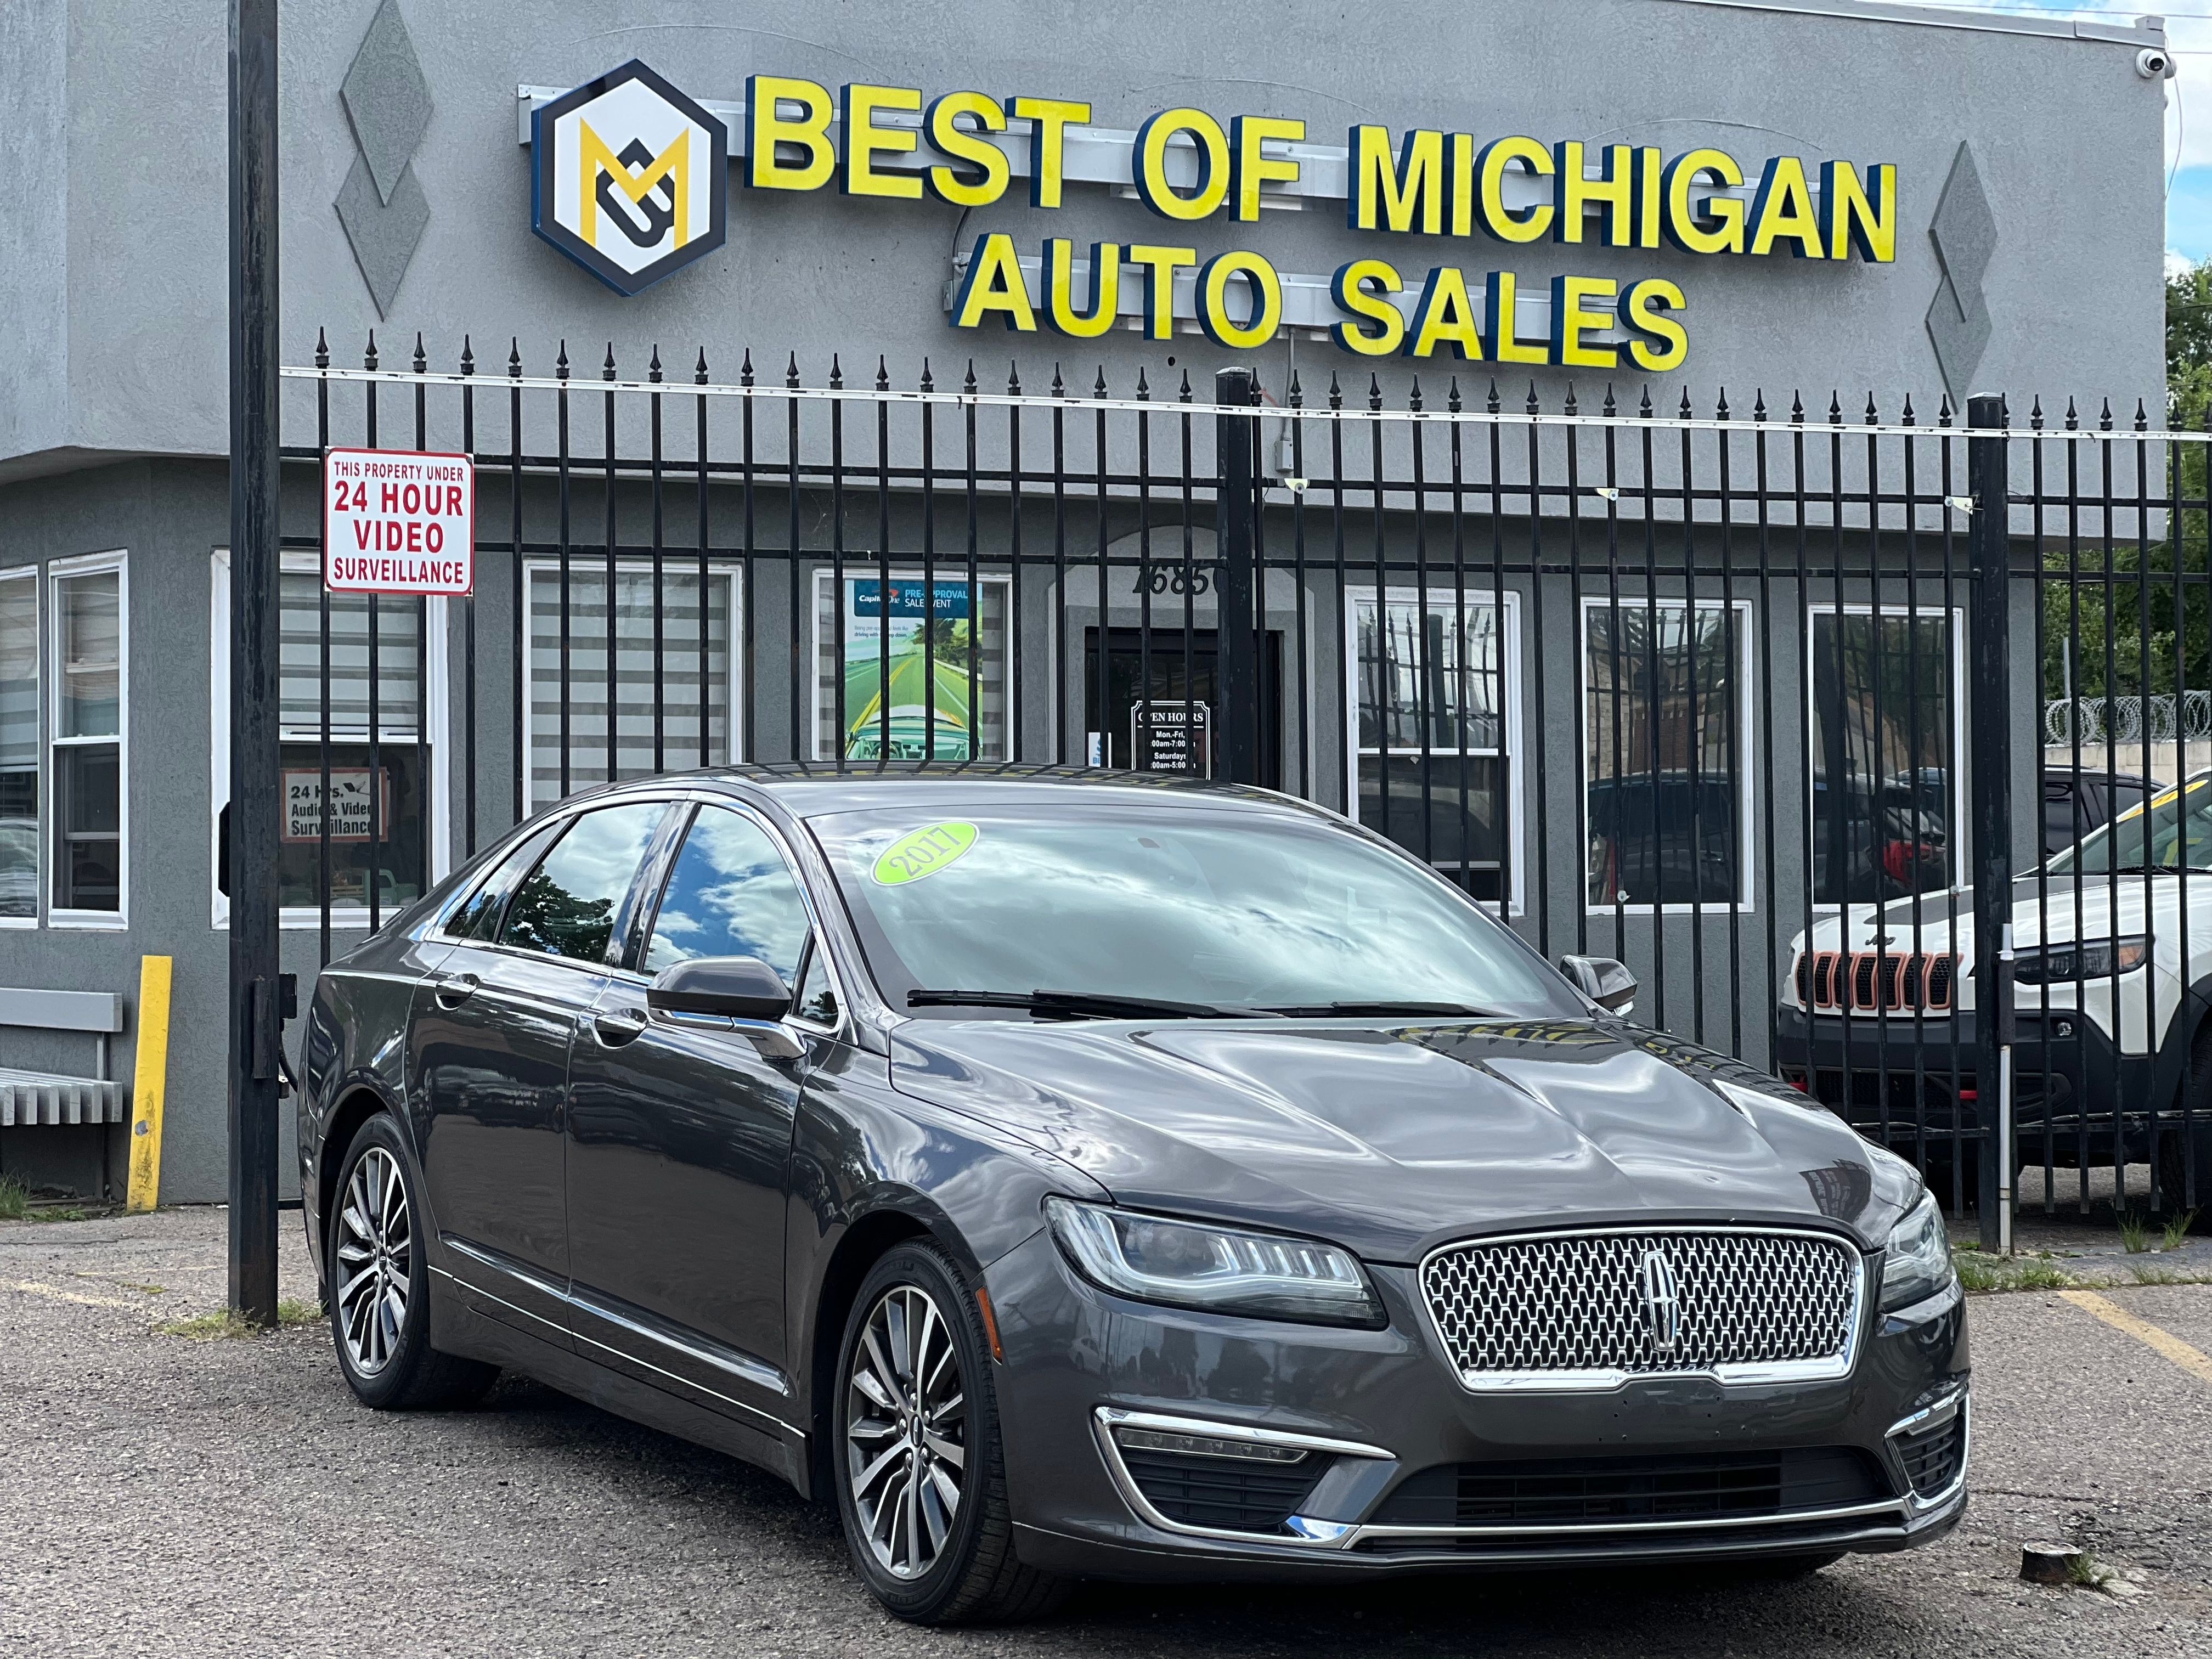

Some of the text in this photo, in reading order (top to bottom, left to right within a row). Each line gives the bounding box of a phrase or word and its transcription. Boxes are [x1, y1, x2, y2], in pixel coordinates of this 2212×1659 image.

[746, 75, 1897, 263] BEST OF MICHIGAN
[952, 233, 1688, 371] AUTO SALES
[334, 461, 464, 482] THIS PROPERTY UNDER
[334, 480, 463, 516] 24 HOUR
[353, 520, 443, 553] VIDEO
[334, 557, 463, 584] SURVEILLANCE
[905, 599, 924, 607] SALE
[291, 786, 310, 798] 24
[889, 826, 961, 877] 2017
